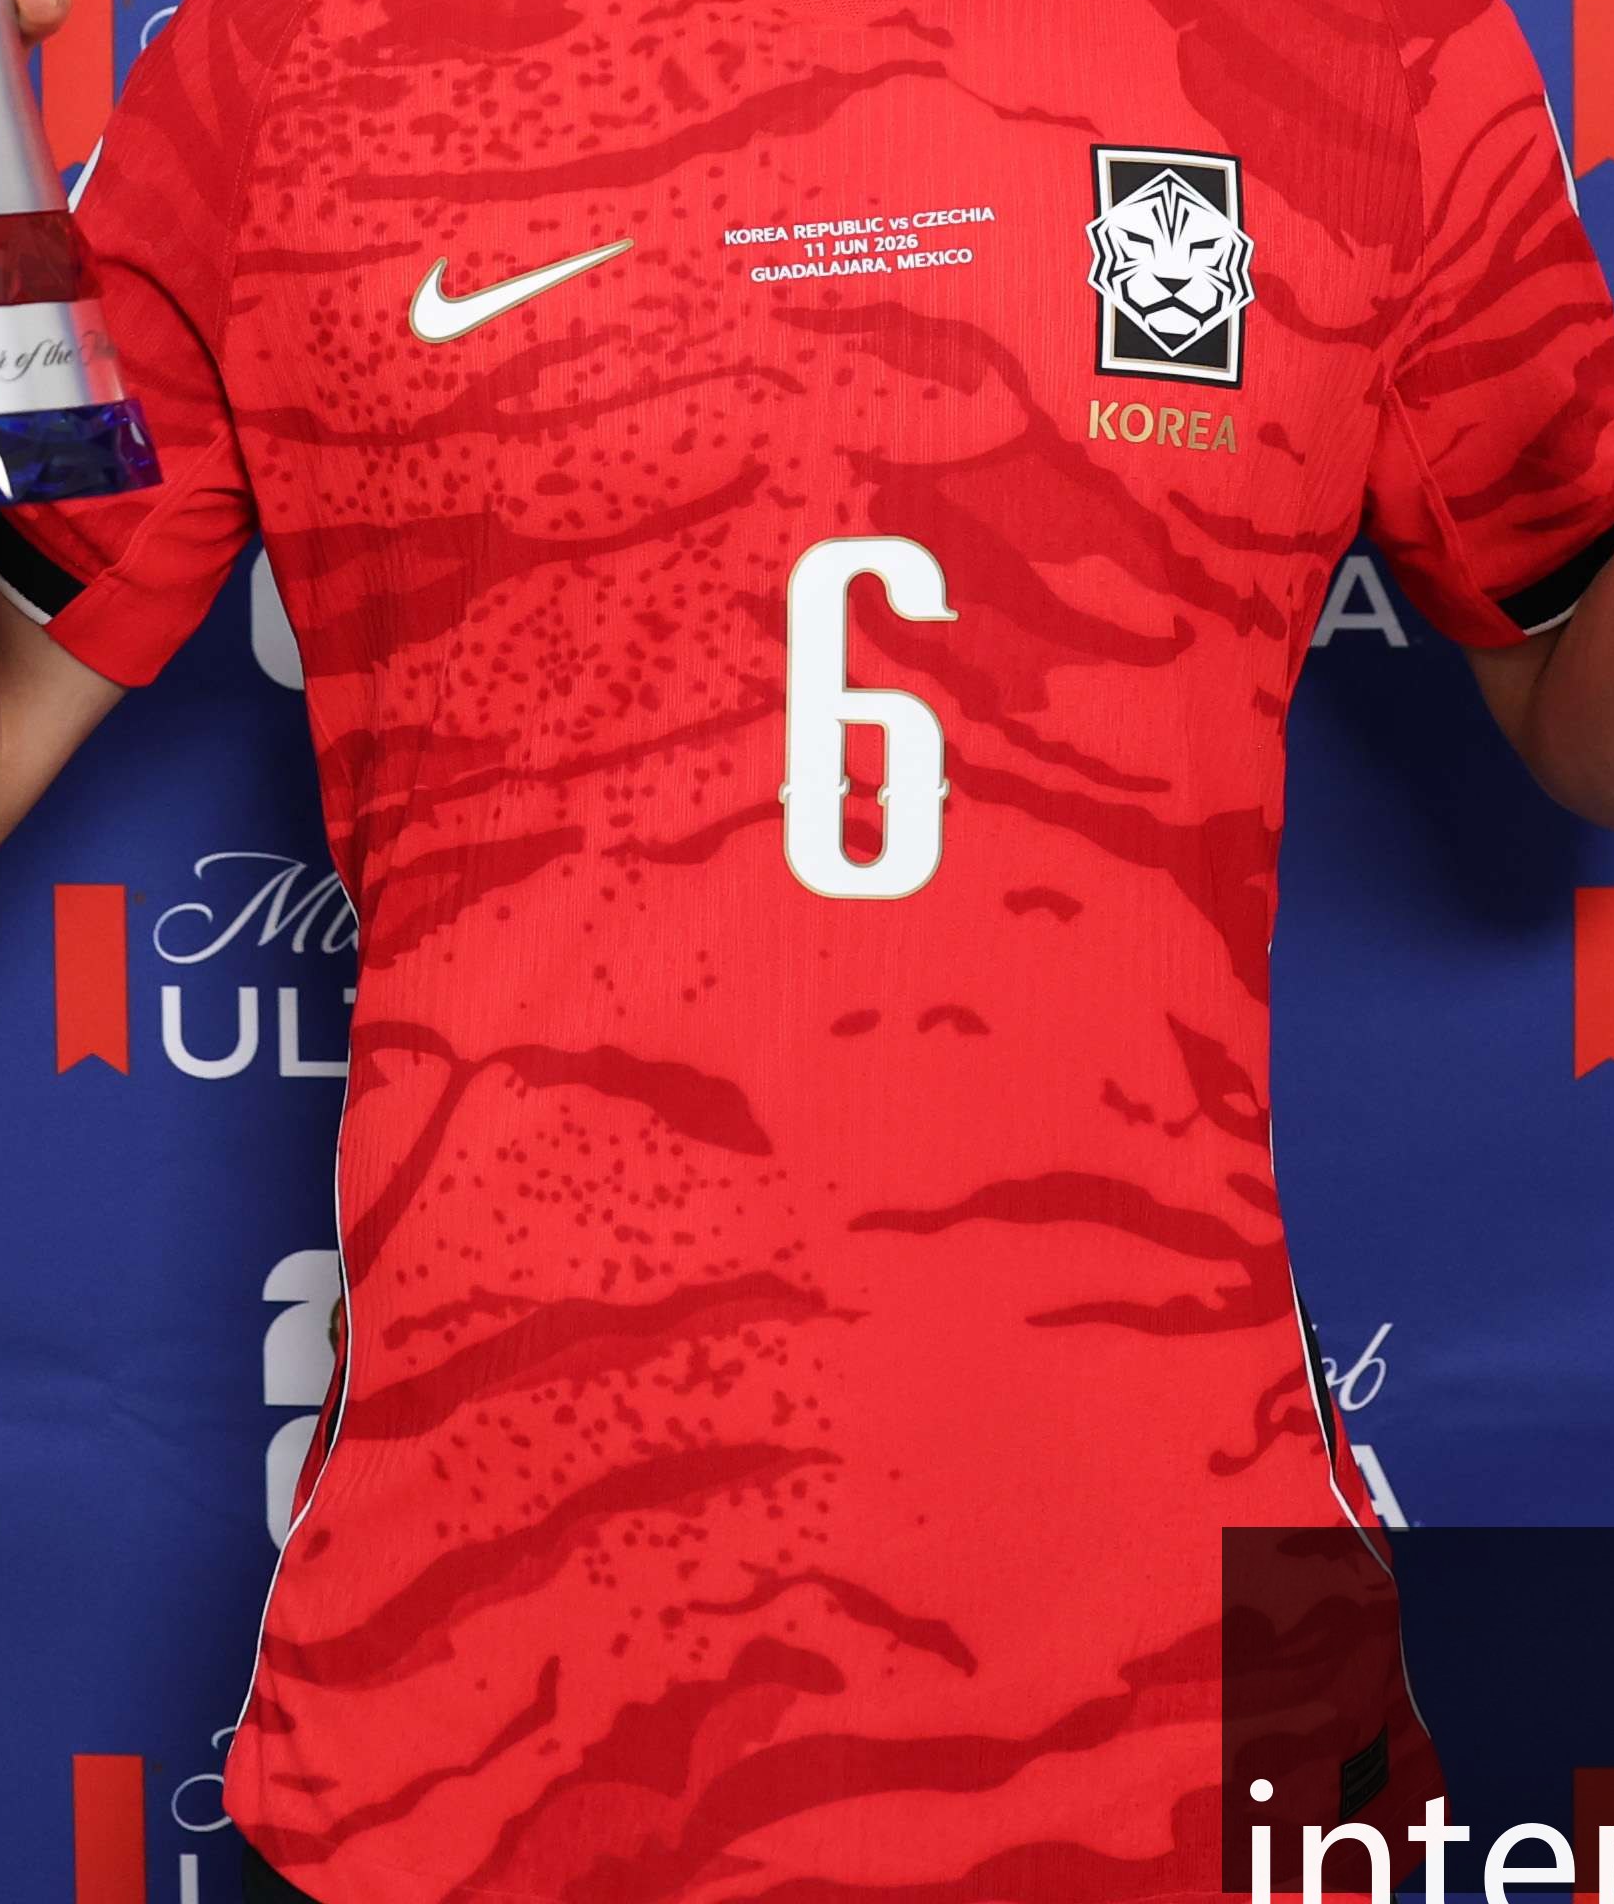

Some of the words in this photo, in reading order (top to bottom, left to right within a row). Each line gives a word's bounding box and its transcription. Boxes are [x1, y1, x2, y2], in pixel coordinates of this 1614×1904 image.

[724, 226, 788, 246] KOREA
[793, 216, 884, 240] REPUBLIC
[889, 218, 908, 231] vs
[912, 206, 995, 229] CZECHIA
[803, 242, 825, 258] 11
[832, 239, 868, 257] JUN
[873, 234, 918, 253] 2026
[750, 260, 892, 283] GUADALAJARA,
[897, 248, 973, 271] MEXICO
[0, 337, 52, 383] of
[1088, 400, 1239, 454] KOREA
[778, 535, 960, 900] 6
